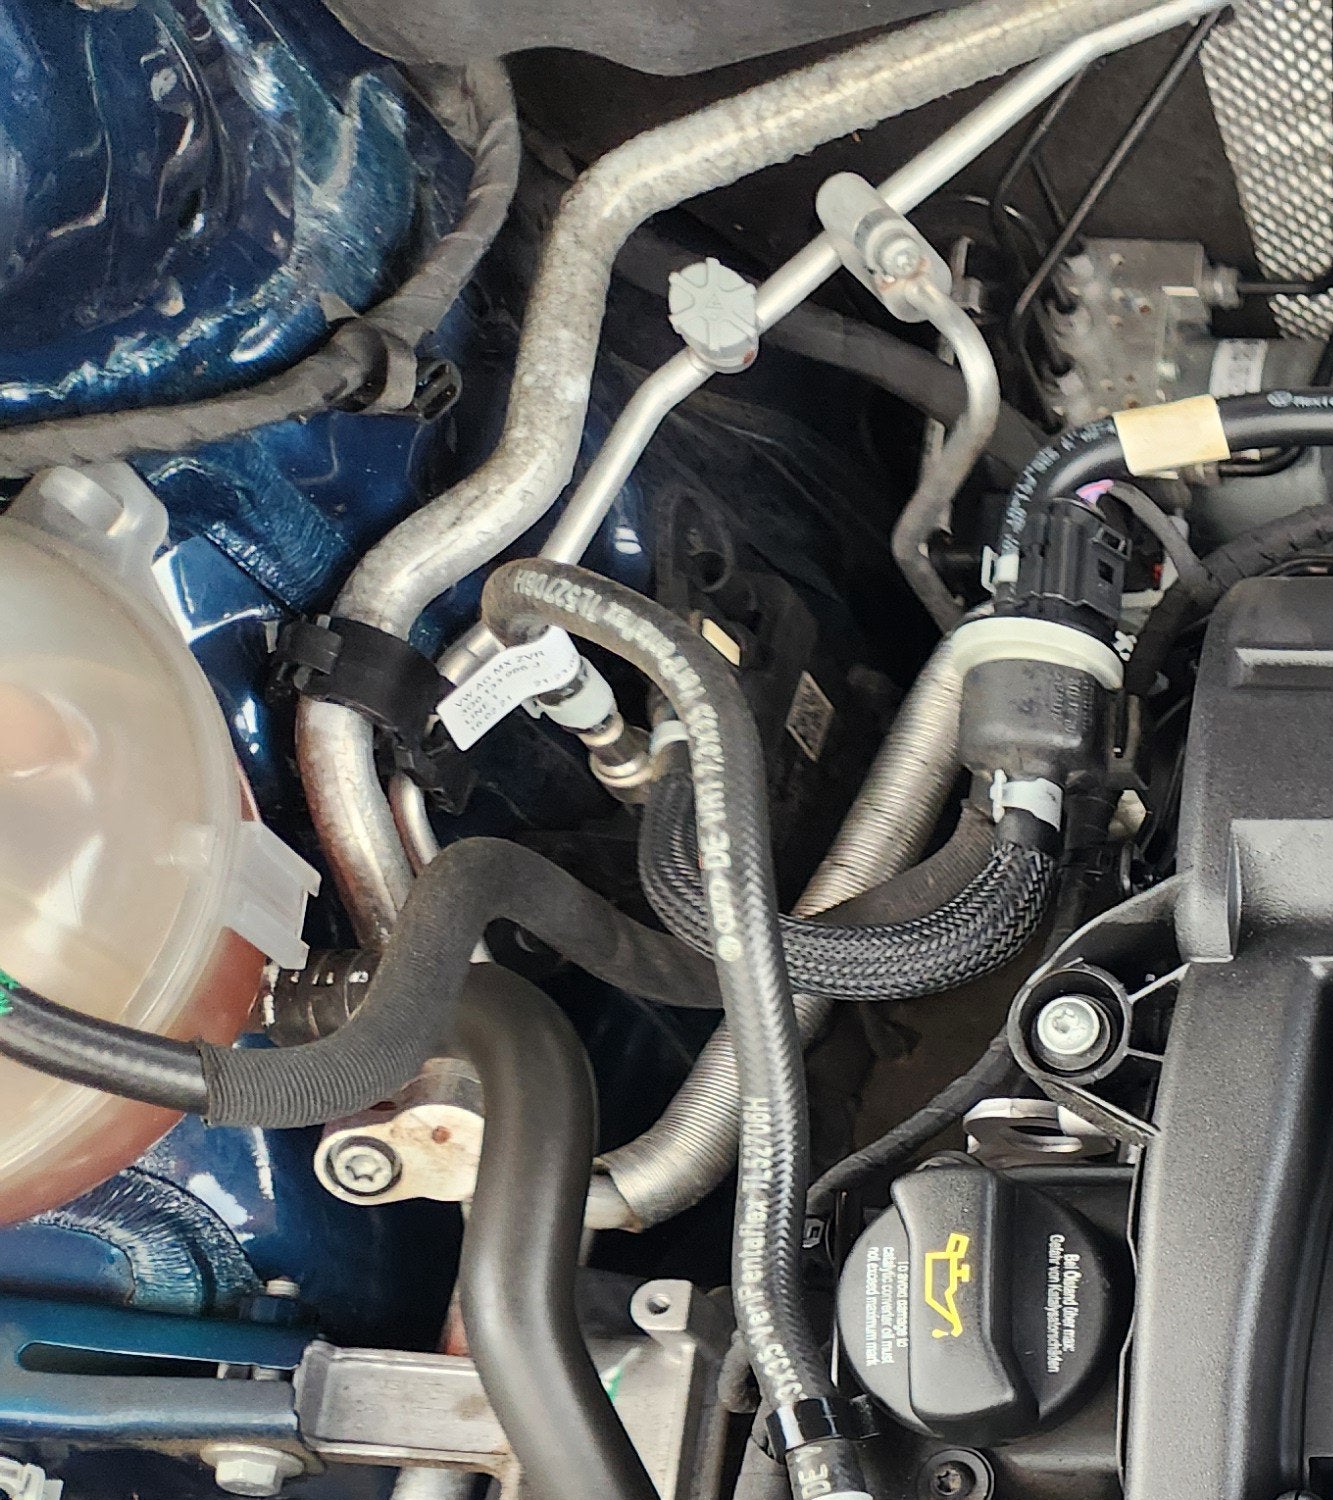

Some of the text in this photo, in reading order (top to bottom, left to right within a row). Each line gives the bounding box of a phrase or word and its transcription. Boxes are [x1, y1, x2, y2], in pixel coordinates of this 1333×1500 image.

[701, 831, 731, 870] DE
[742, 1096, 771, 1193] TL52706H
[880, 1246, 896, 1283] catalytic
[1048, 1233, 1066, 1266] Gefahr
[1047, 1266, 1061, 1283] von
[865, 1246, 880, 1367] not exceed maximum mark
[881, 1284, 895, 1327] converter
[881, 1340, 895, 1365] must
[798, 1462, 832, 1500] DE
